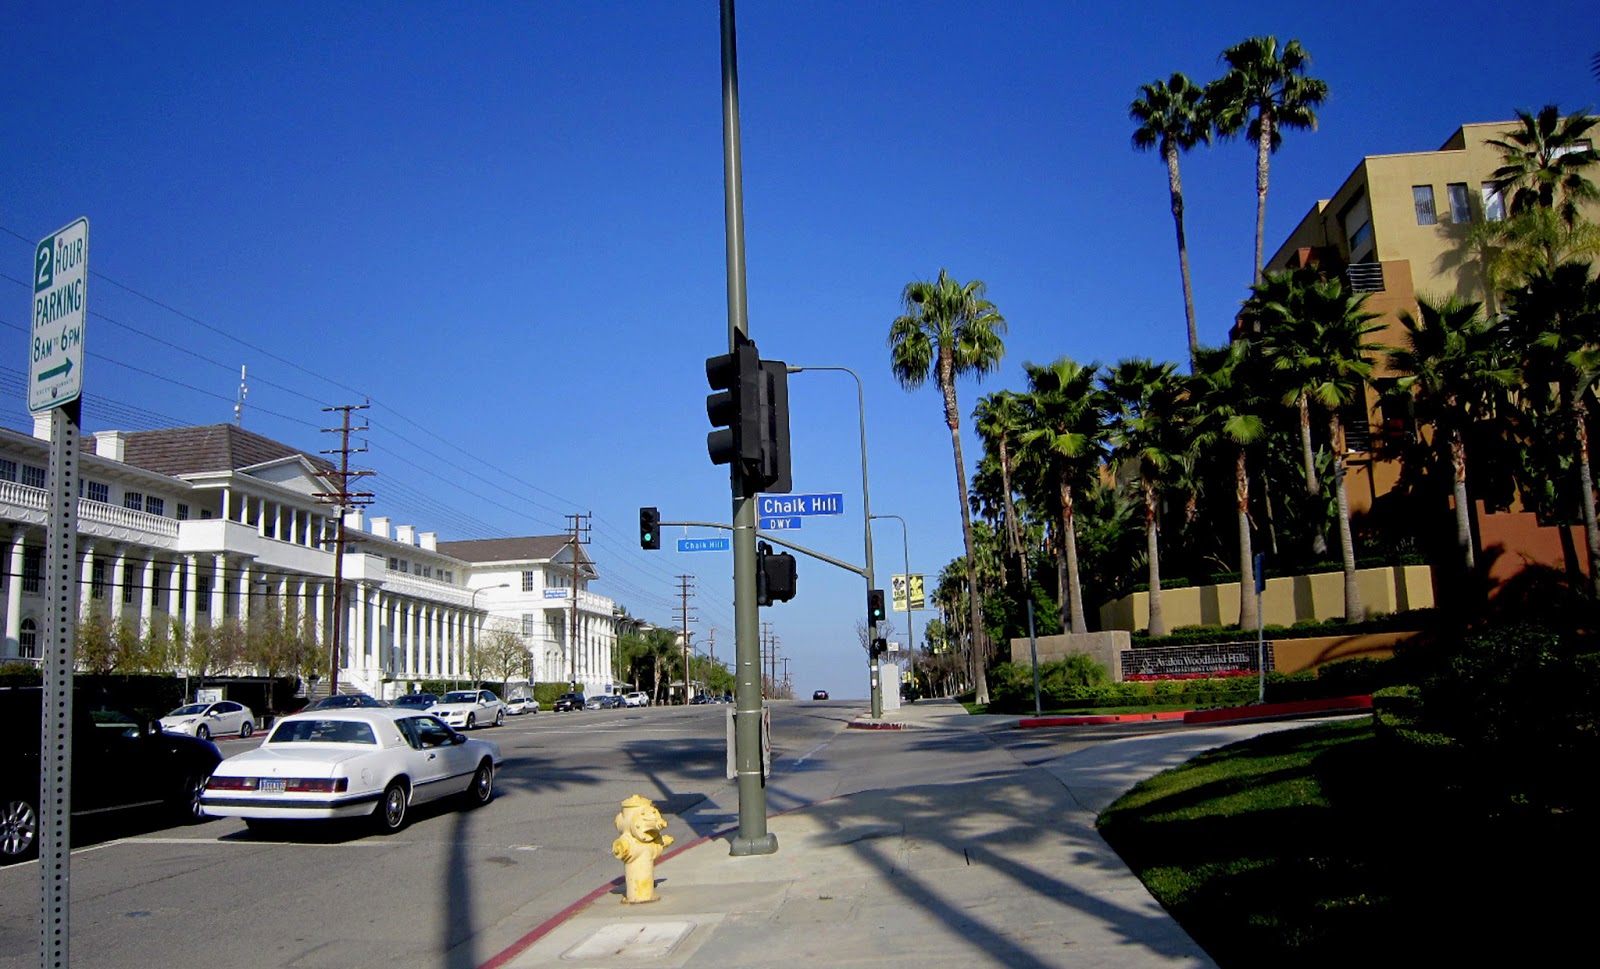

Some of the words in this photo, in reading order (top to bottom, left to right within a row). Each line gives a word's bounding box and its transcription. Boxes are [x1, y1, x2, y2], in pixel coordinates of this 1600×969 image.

[38, 246, 51, 284] 2
[55, 238, 82, 276] HOUR
[35, 278, 82, 329] PARKING
[33, 336, 52, 363] 8AM
[60, 325, 80, 352] 6PM
[764, 498, 806, 513] Chalk
[812, 497, 837, 512] Hill
[770, 519, 791, 529] DWY
[684, 541, 707, 550] Chalk
[709, 541, 723, 549] Hill
[1156, 657, 1183, 667] Avalon
[1183, 655, 1226, 666] Woodland
[1228, 653, 1249, 663] Hills
